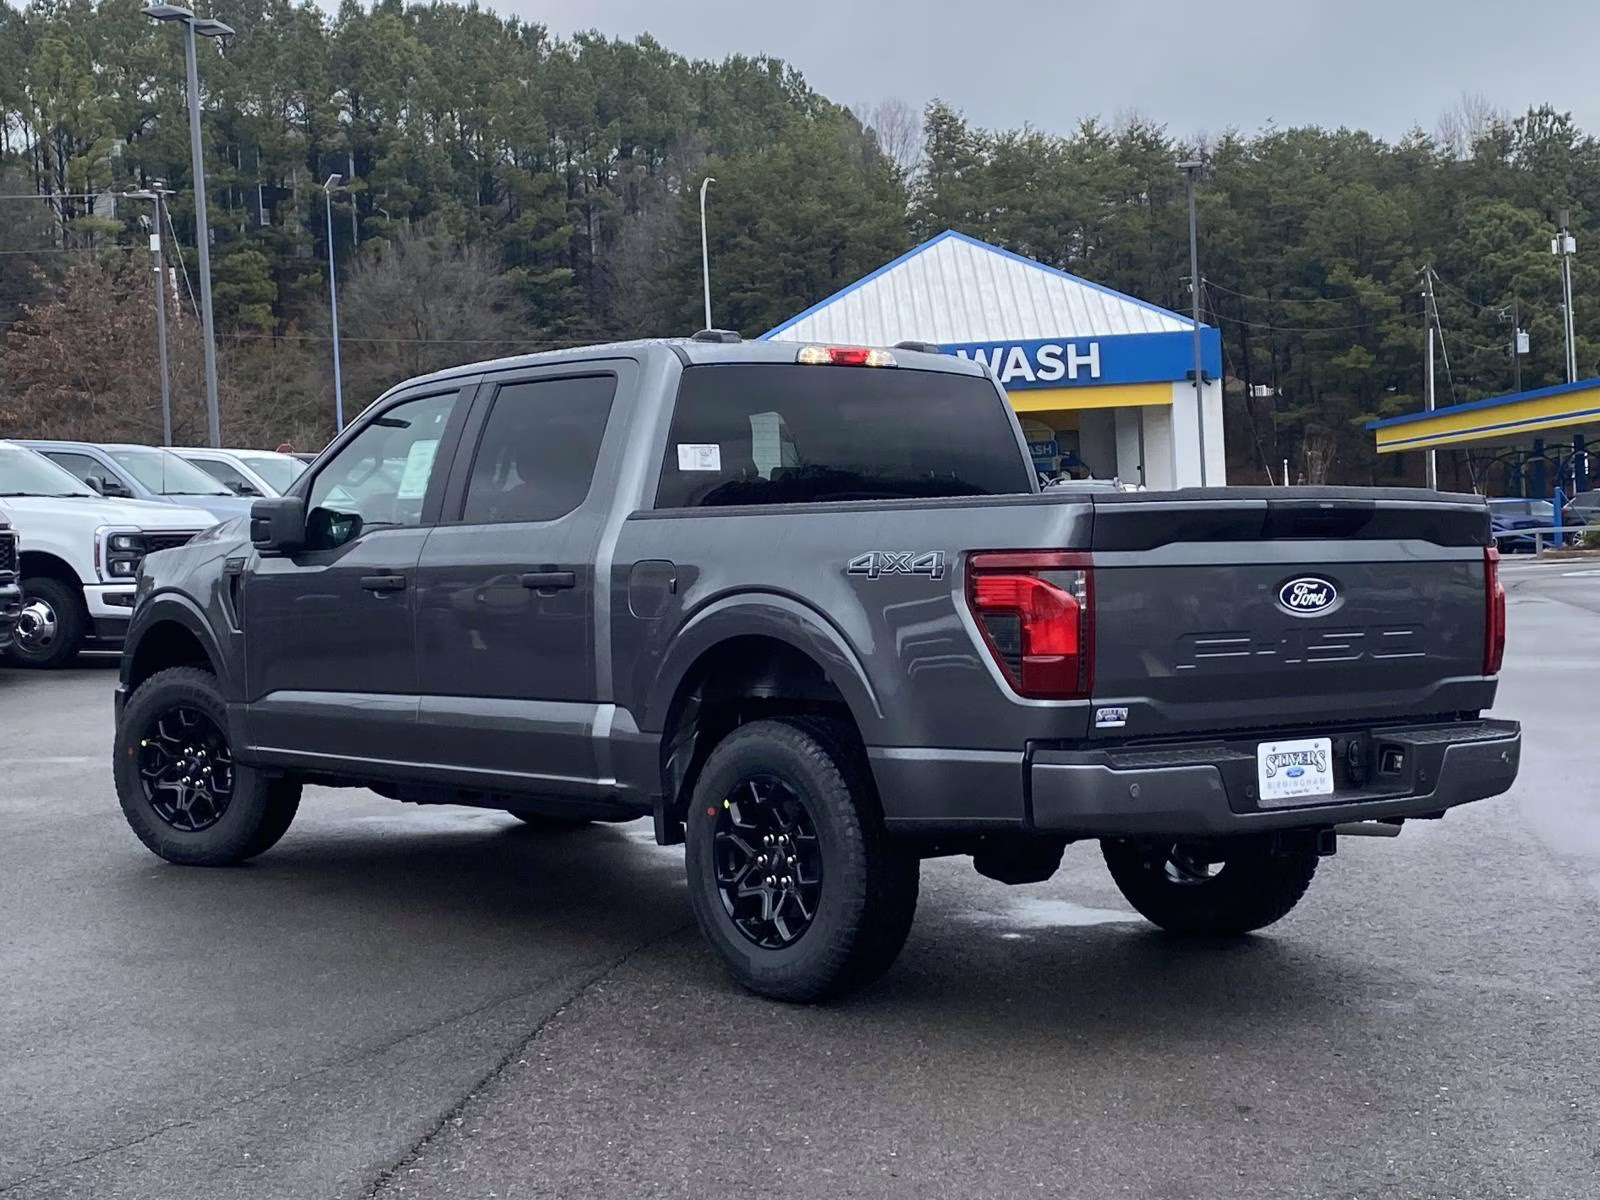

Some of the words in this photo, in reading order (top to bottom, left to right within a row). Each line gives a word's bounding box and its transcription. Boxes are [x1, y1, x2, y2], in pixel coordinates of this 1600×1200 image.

[956, 342, 1101, 383] WASH
[1029, 444, 1053, 455] ASH
[1290, 582, 1328, 606] Ford
[1266, 750, 1326, 778] STIVERS
